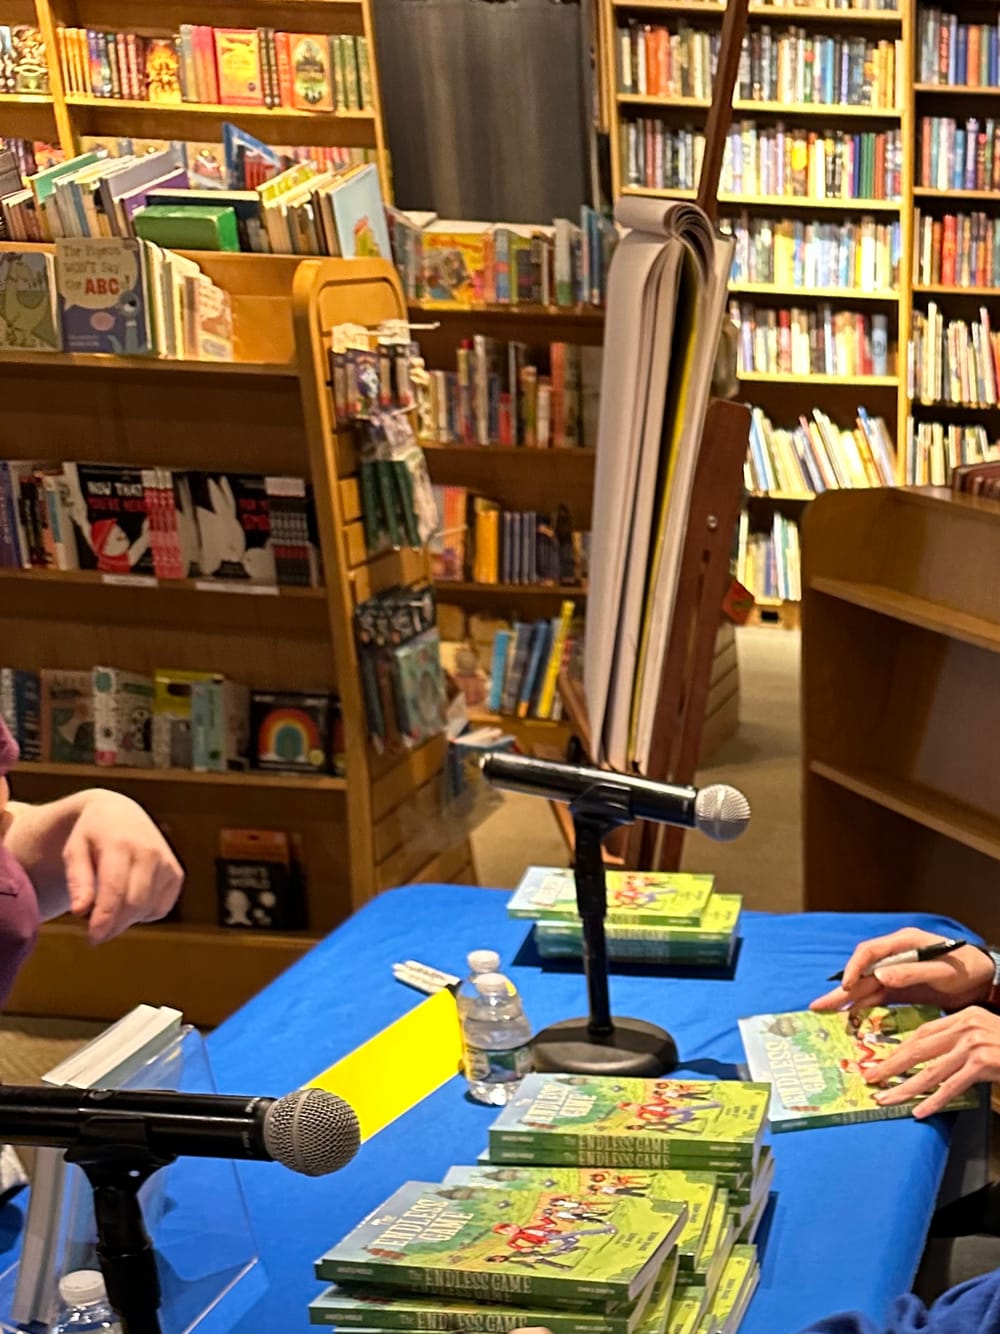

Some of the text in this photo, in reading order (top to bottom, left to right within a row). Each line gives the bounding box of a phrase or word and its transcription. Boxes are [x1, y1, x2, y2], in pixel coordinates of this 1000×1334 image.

[578, 1134, 634, 1150] ENDLESS
[636, 1137, 671, 1153] GAME
[578, 1151, 634, 1168] ENDLESS
[636, 1153, 670, 1168] GAME
[373, 1199, 449, 1247] ENDLESS
[418, 1211, 475, 1241] GAME
[424, 1268, 489, 1290] ENDLESS
[491, 1273, 533, 1294] GAME
